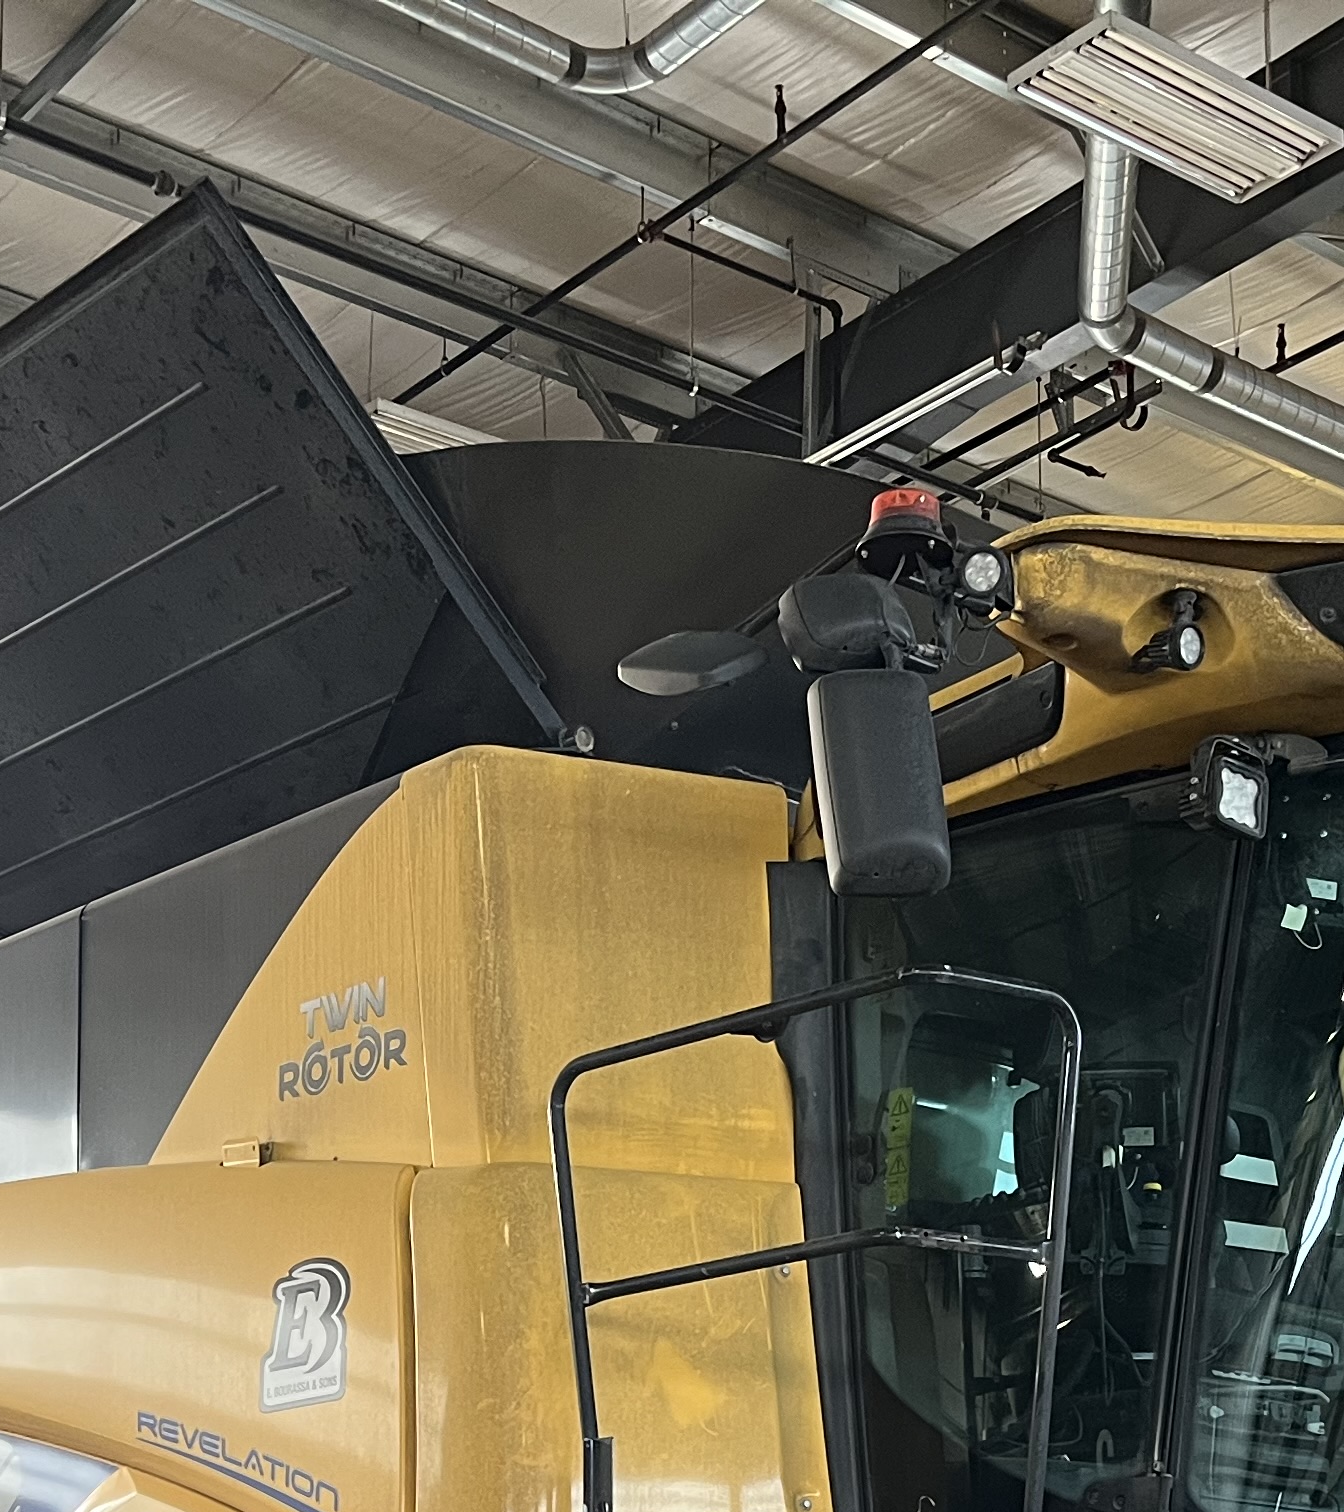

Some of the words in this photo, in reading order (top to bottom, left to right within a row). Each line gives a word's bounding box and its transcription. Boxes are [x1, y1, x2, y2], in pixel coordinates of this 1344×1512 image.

[299, 975, 387, 1040] TWIN
[278, 1025, 408, 1102] ROTOR
[318, 1375, 338, 1389] SONS
